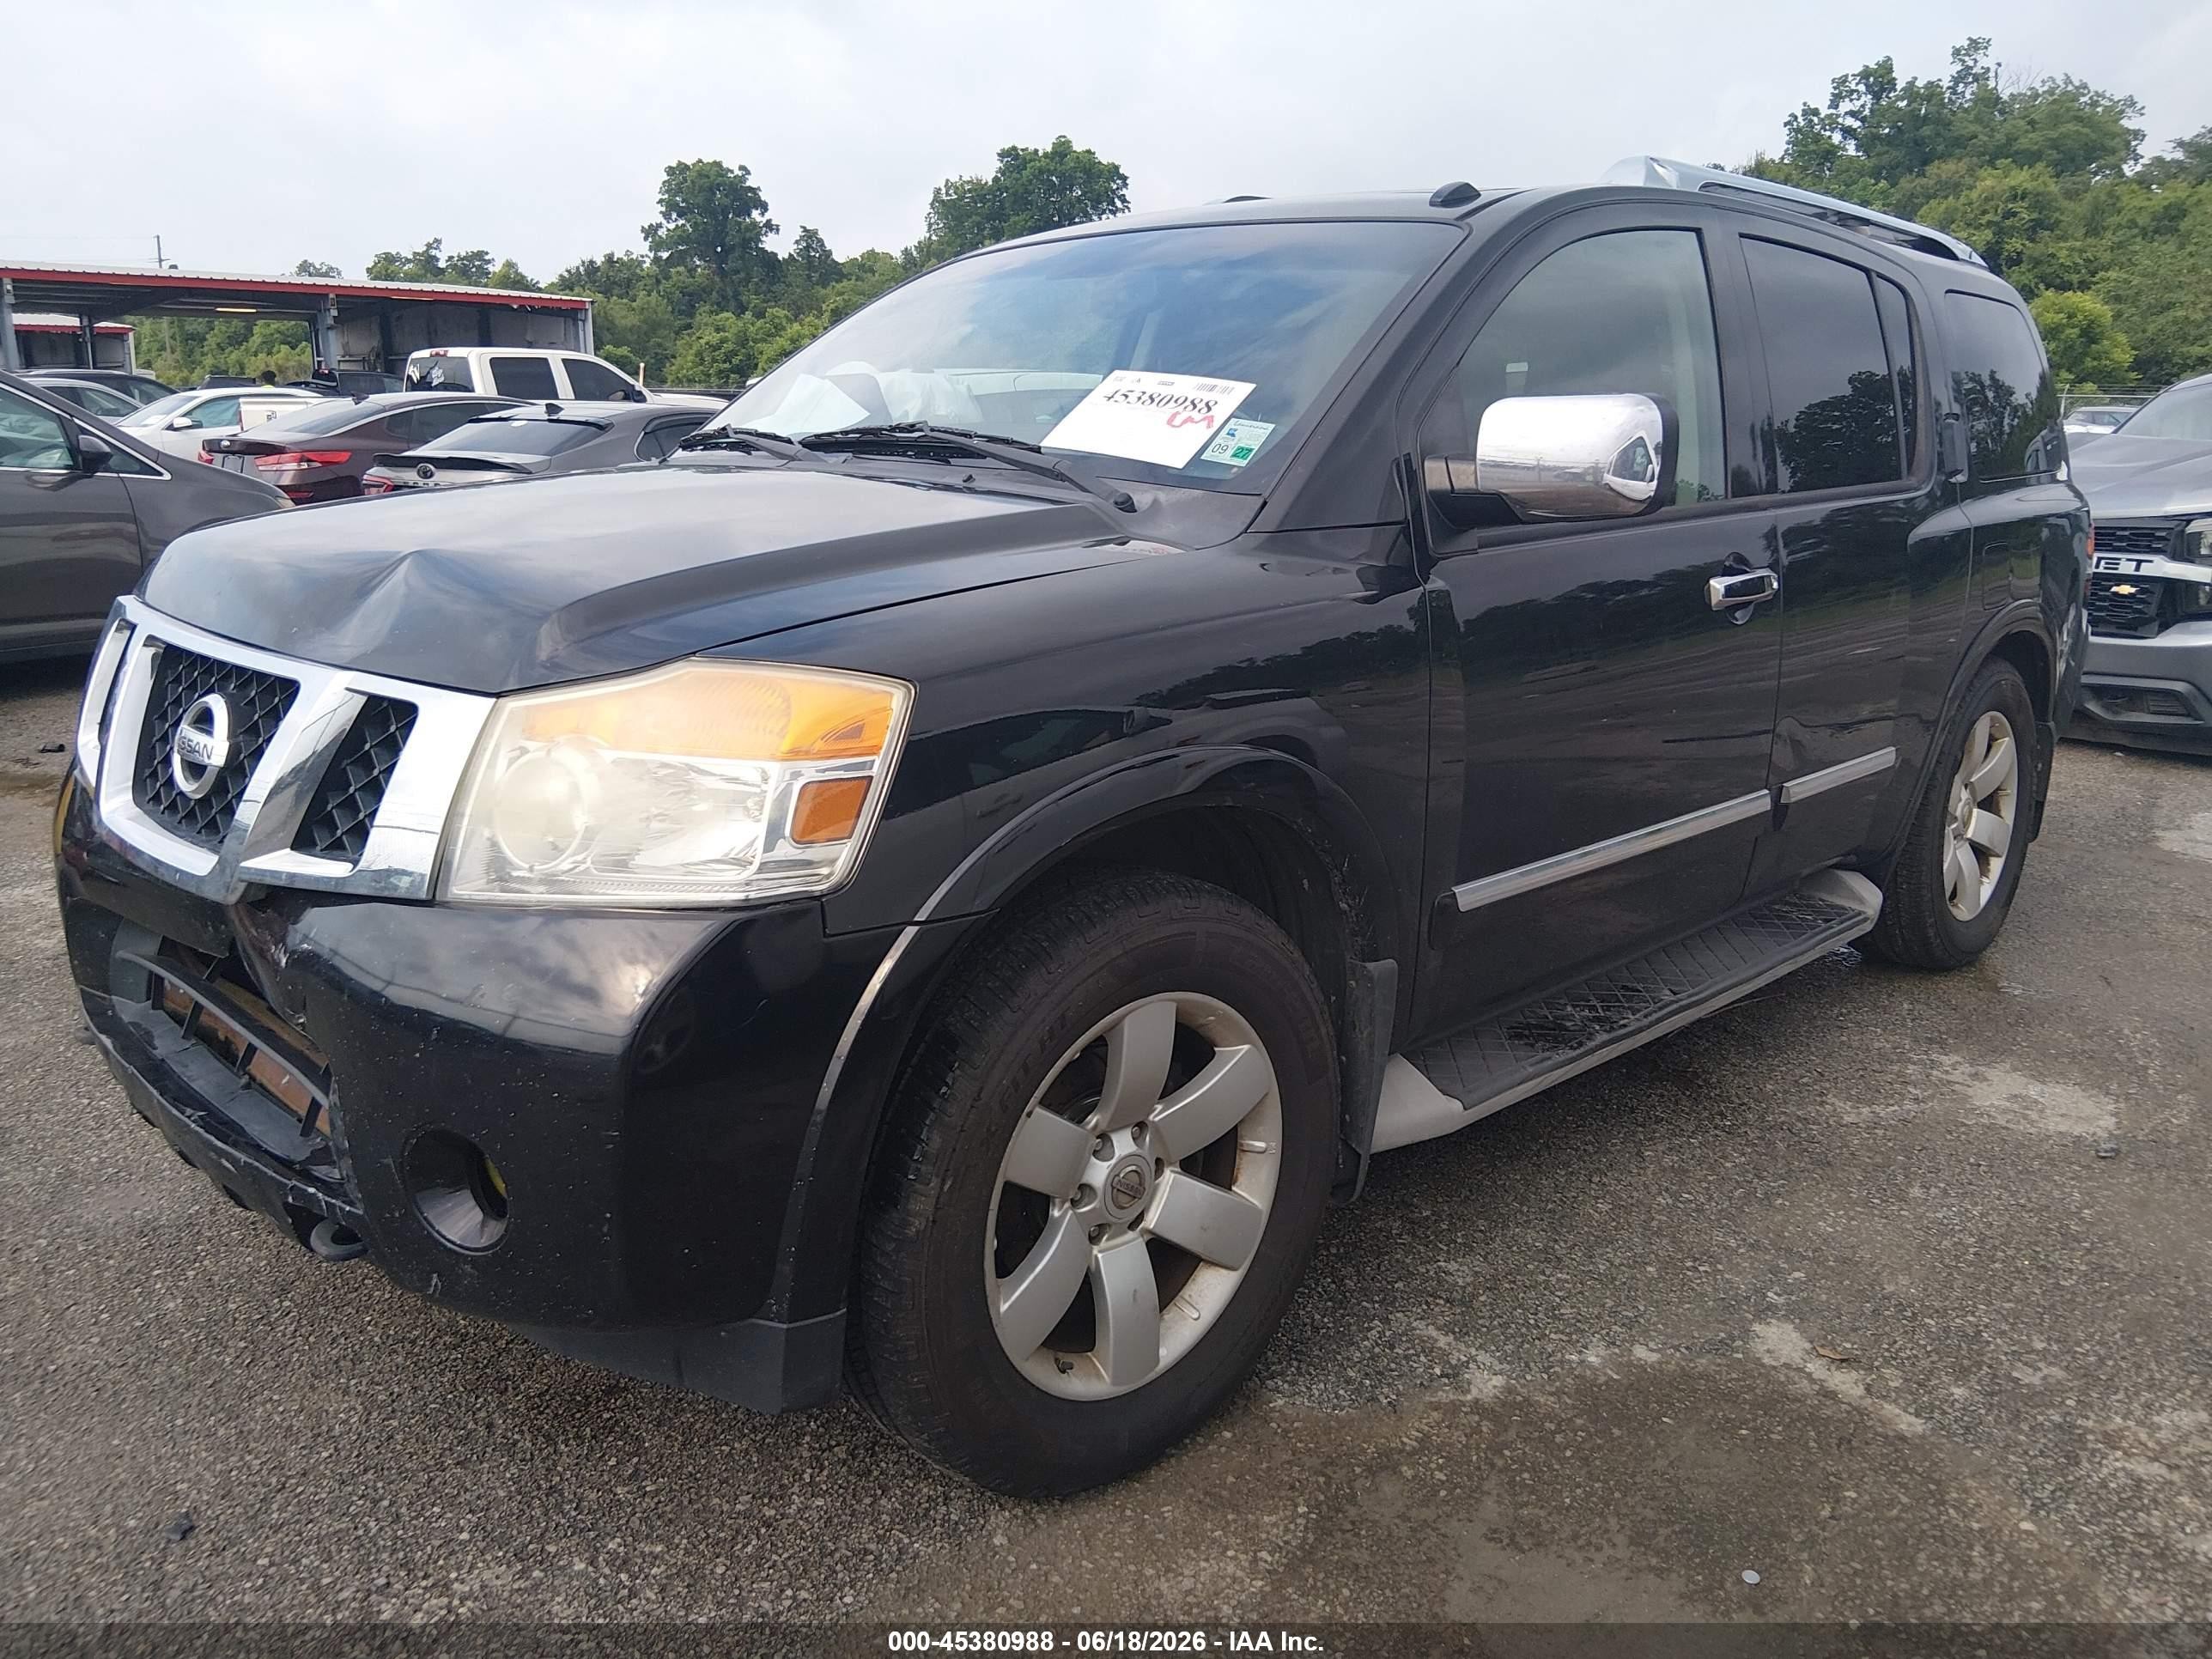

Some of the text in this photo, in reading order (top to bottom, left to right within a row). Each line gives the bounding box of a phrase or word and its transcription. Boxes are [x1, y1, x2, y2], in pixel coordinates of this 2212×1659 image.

[1103, 389, 1218, 414] 45380988
[1212, 444, 1252, 459] 09 27
